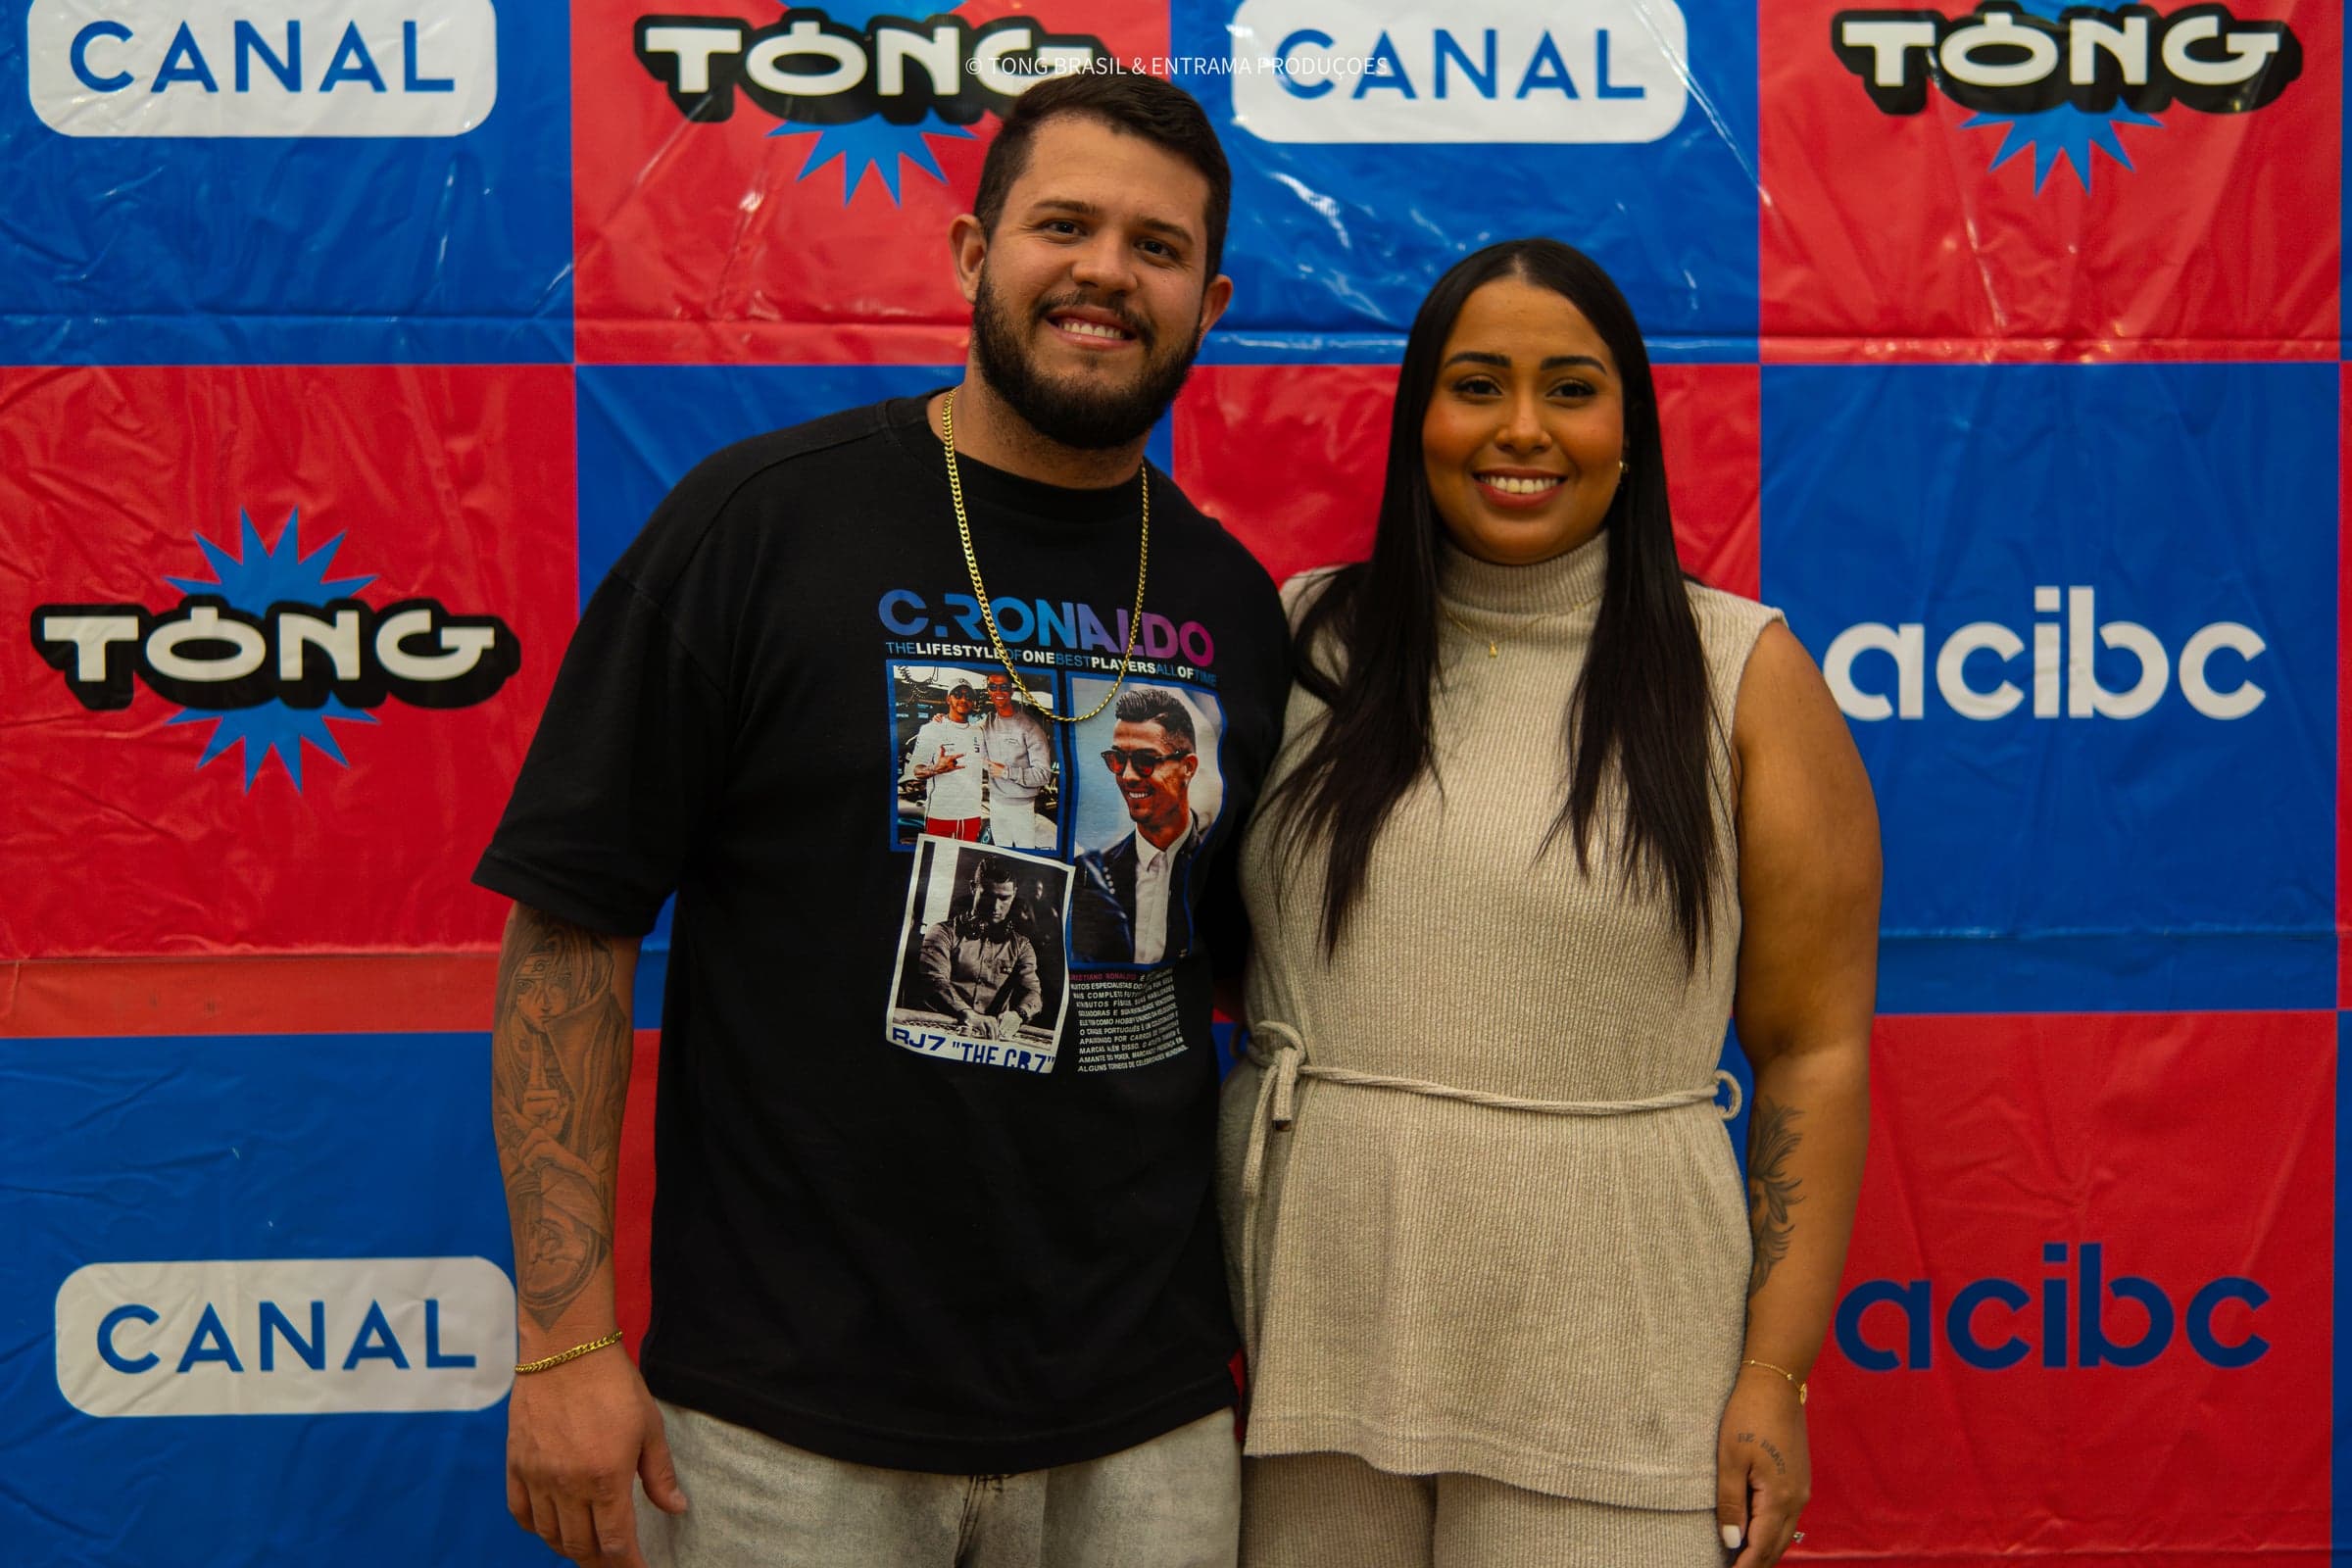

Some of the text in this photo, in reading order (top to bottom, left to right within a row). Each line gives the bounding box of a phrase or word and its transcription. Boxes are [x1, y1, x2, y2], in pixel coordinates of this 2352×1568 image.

[69, 19, 455, 93] CANAL
[642, 20, 1095, 99] TONG
[1274, 28, 1644, 99] CANAL
[1839, 11, 2281, 88] TONG
[42, 604, 496, 684] TONG
[1822, 585, 2267, 722] acibc
[96, 1298, 477, 1375] CANAL
[1834, 1242, 2271, 1373] acibc
